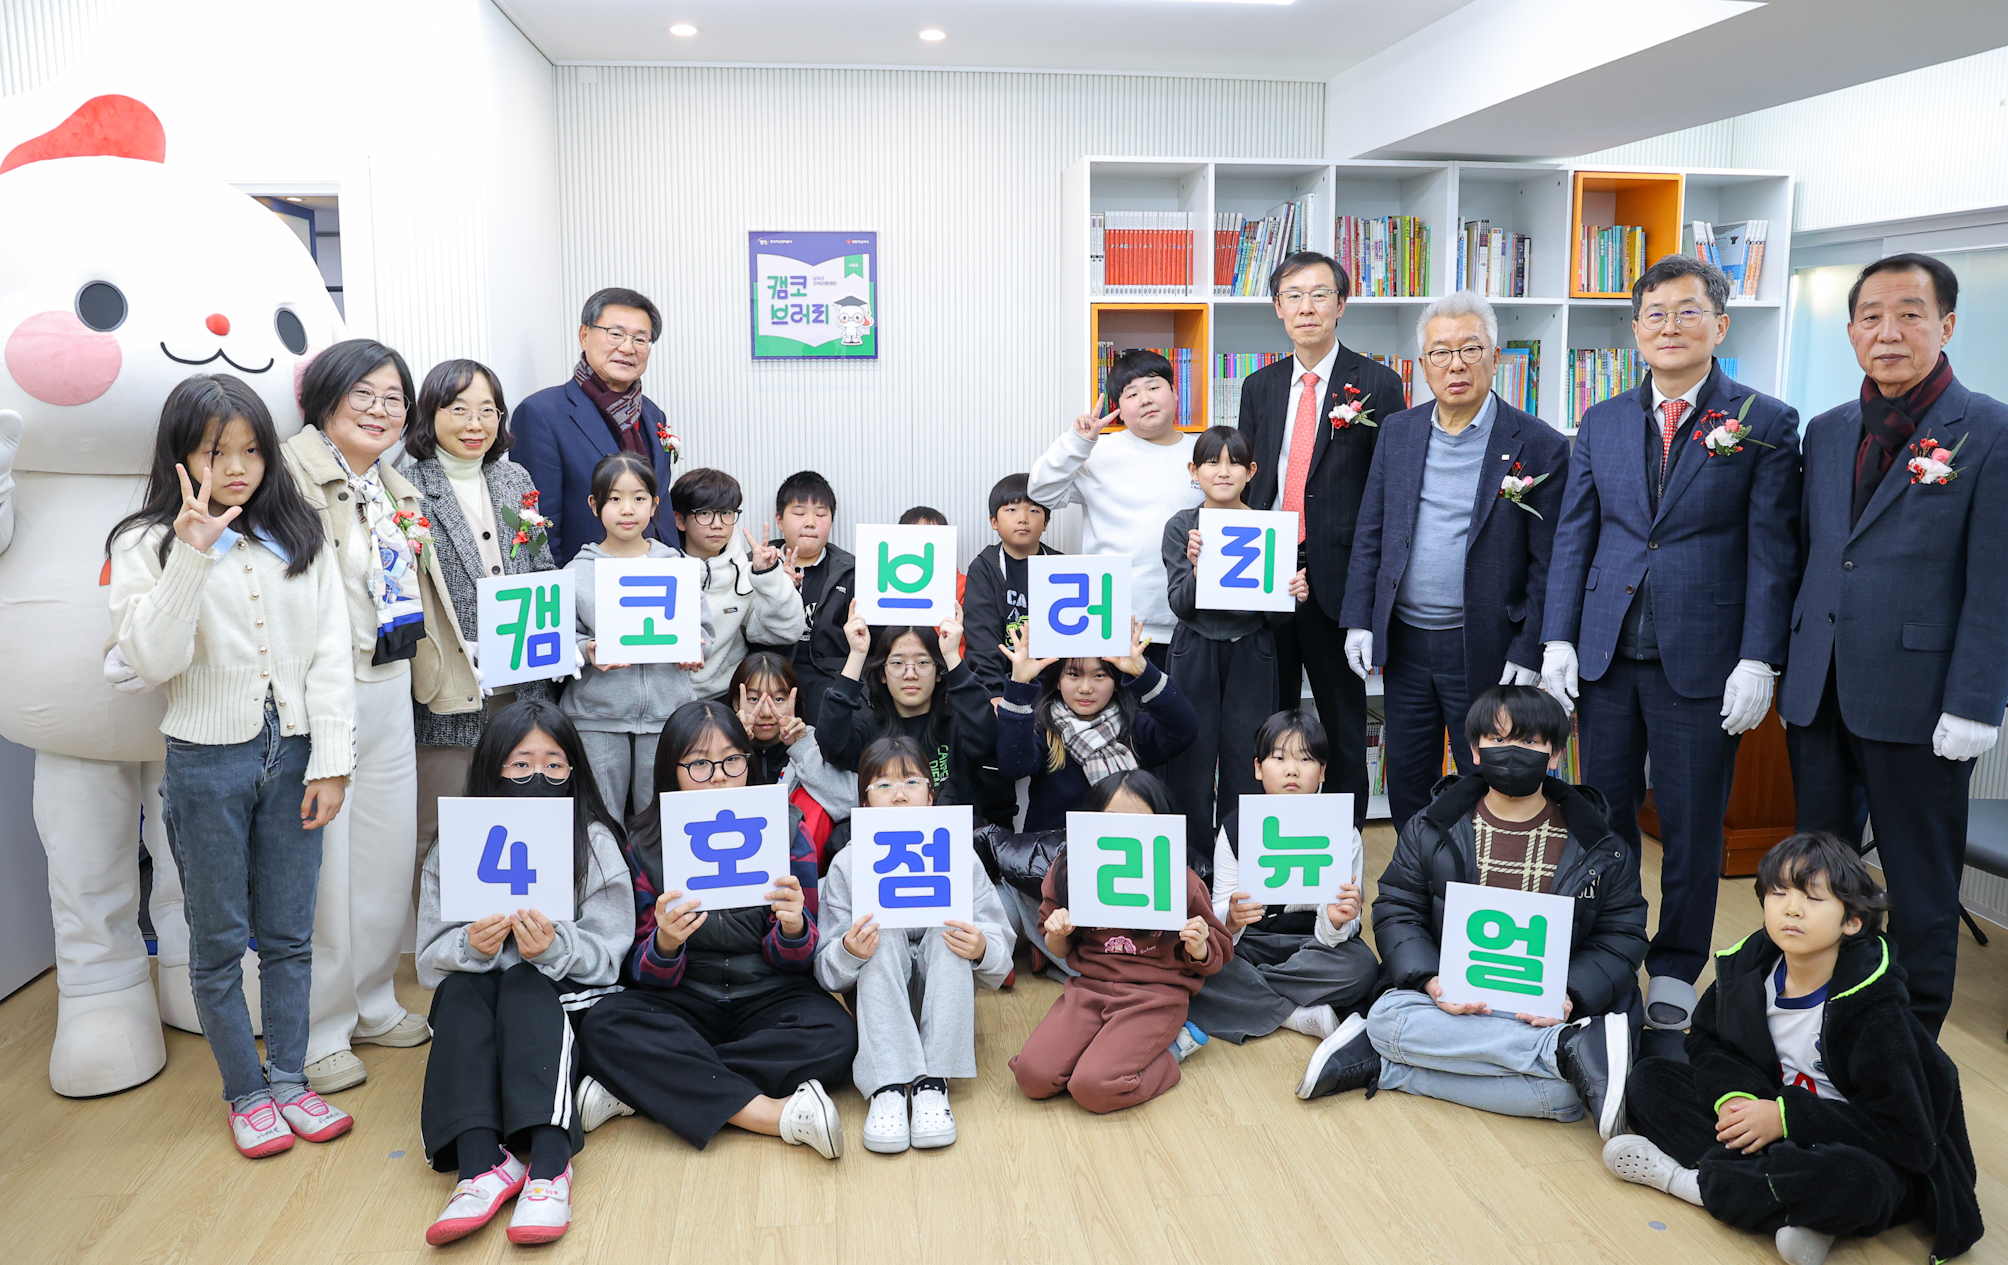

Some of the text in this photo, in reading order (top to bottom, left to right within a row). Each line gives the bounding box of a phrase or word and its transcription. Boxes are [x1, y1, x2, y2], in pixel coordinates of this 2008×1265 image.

[767, 276, 807, 300] 캠코
[771, 304, 829, 325] 브러리
[877, 541, 935, 610] 브
[1220, 526, 1276, 595] 리
[495, 583, 561, 672] 캠
[619, 576, 679, 646] 코
[1049, 573, 1113, 641] 러
[477, 825, 538, 897] 4
[683, 809, 770, 891] 호
[873, 827, 952, 910] 점
[1096, 835, 1172, 913] 리
[1258, 816, 1334, 889] 뉴
[1465, 909, 1549, 998] 얼
